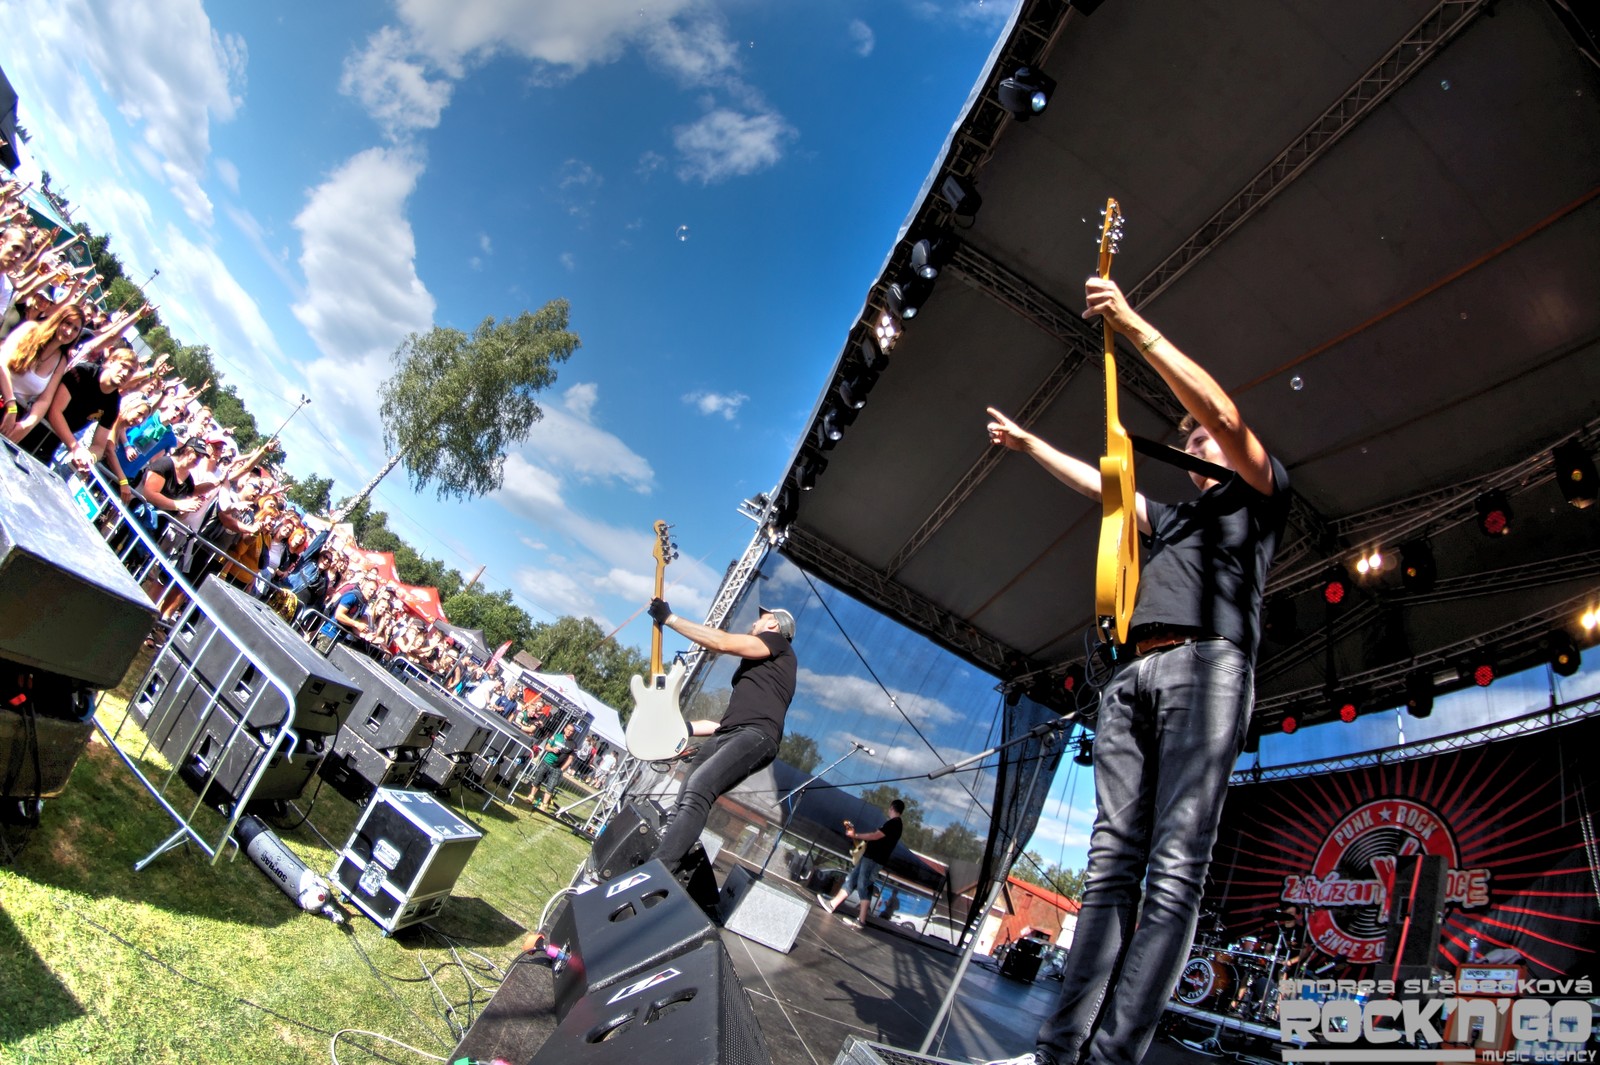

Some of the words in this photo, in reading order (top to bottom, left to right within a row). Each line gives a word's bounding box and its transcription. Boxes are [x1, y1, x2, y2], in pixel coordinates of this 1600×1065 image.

[1333, 810, 1374, 847] PUNK
[1396, 805, 1438, 840] ROCK
[1319, 928, 1361, 958] SINCE
[1362, 941, 1385, 959] 20
